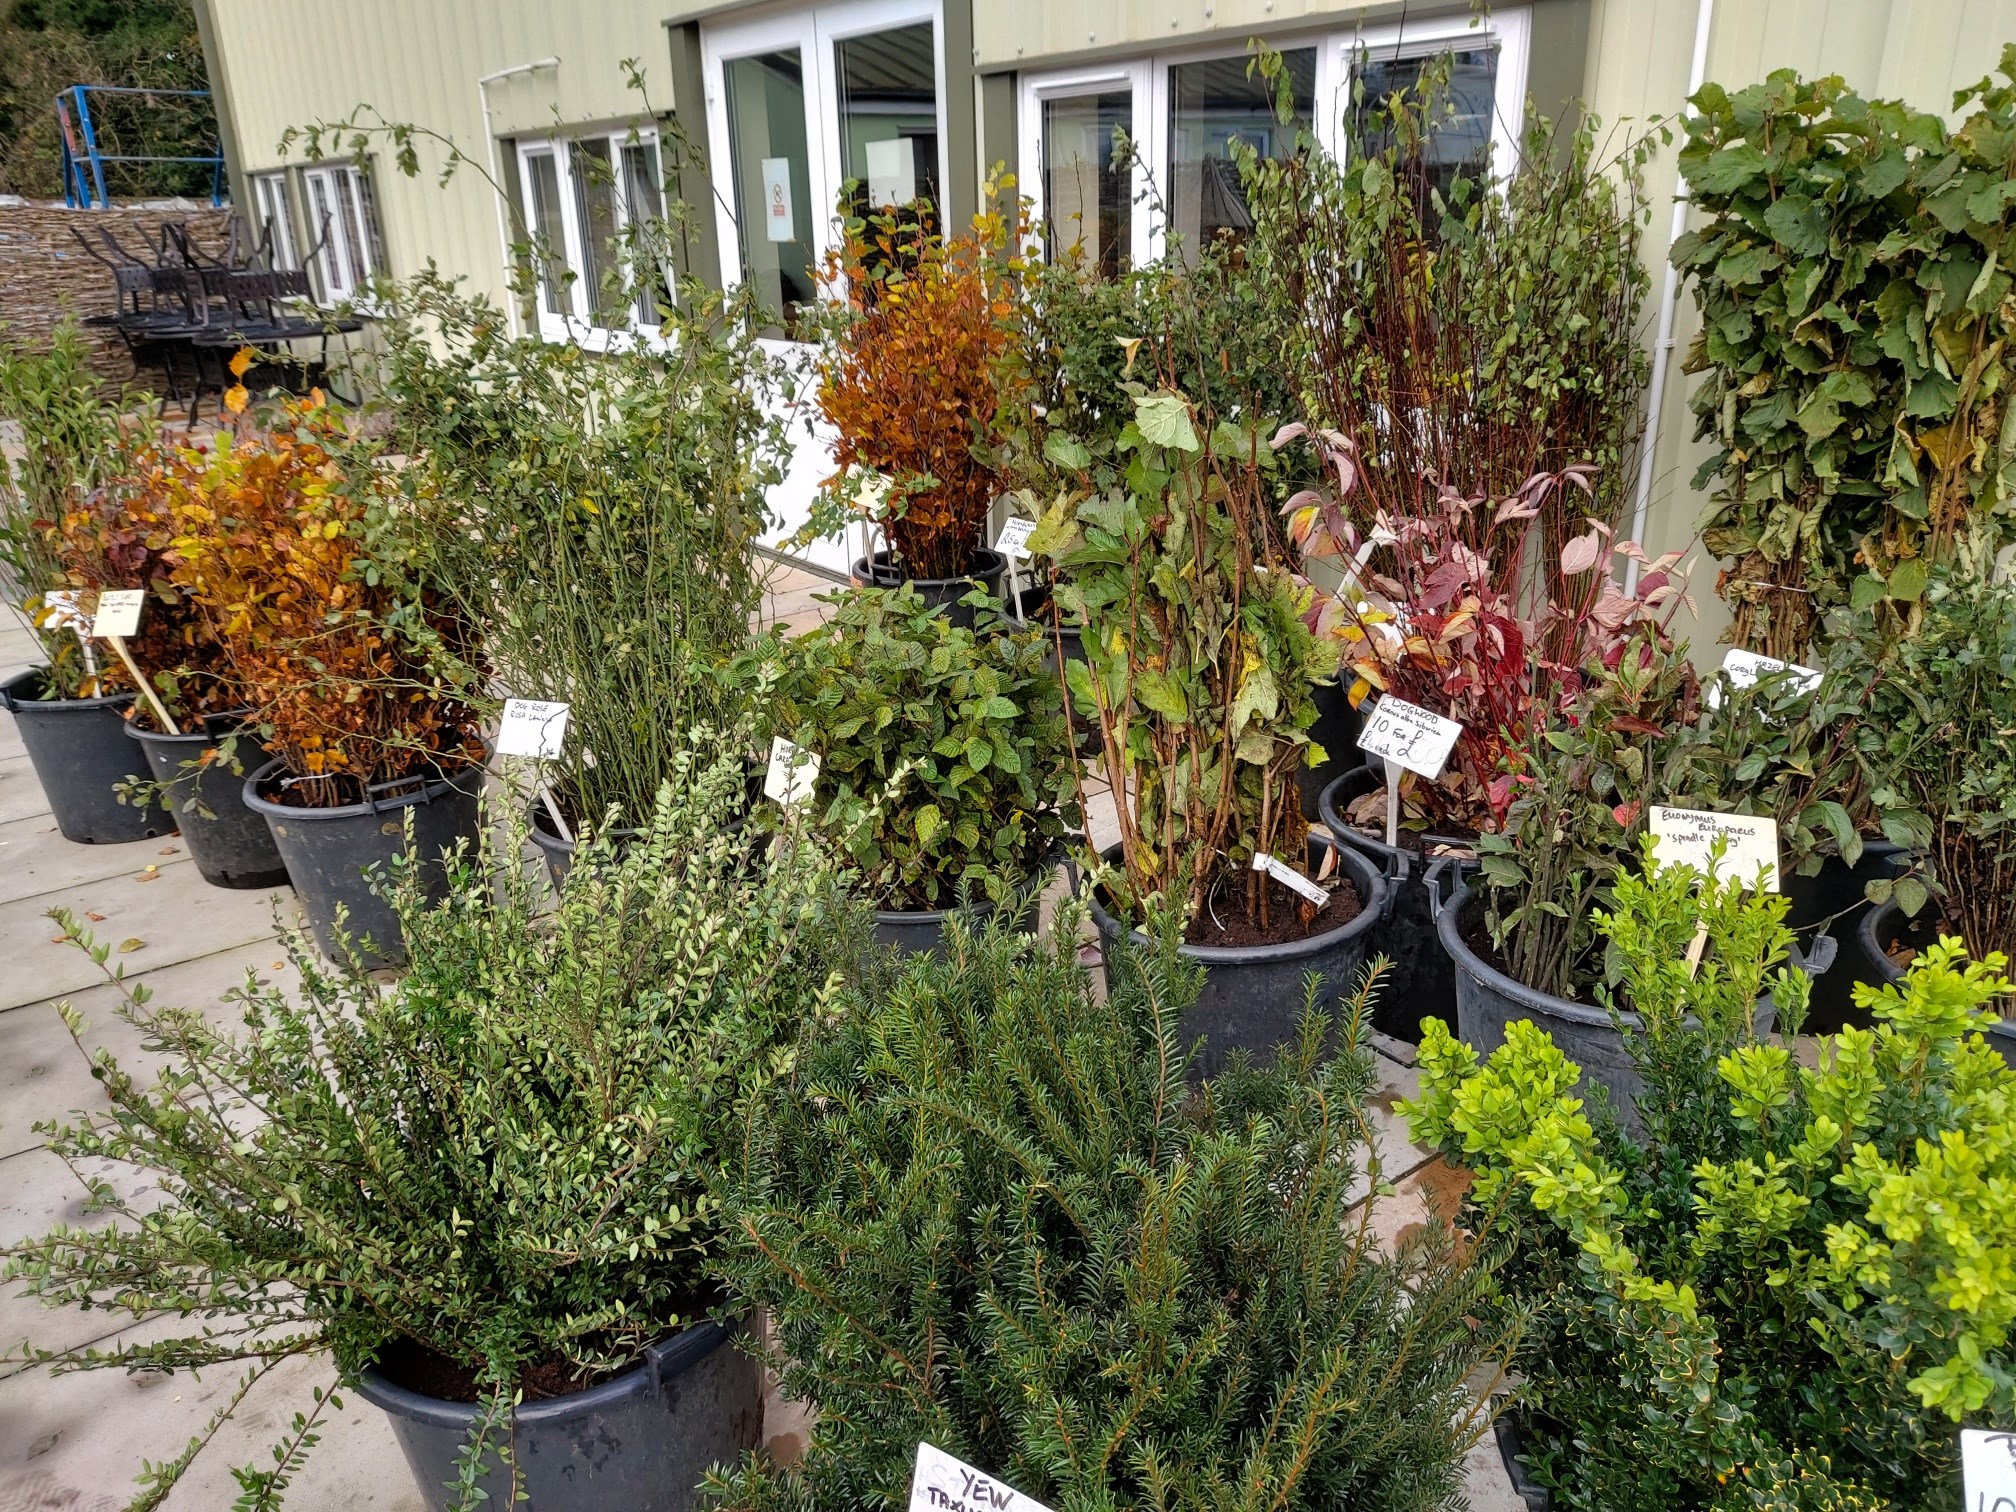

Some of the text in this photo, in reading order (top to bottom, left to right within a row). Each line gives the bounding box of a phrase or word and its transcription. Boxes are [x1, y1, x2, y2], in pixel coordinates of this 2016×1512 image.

[510, 710, 526, 719] ROSA
[514, 701, 549, 712] DOG ROSE
[1388, 696, 1439, 724] DOGWOOD
[1372, 715, 1389, 732] 10
[959, 1467, 1014, 1511] YEW
